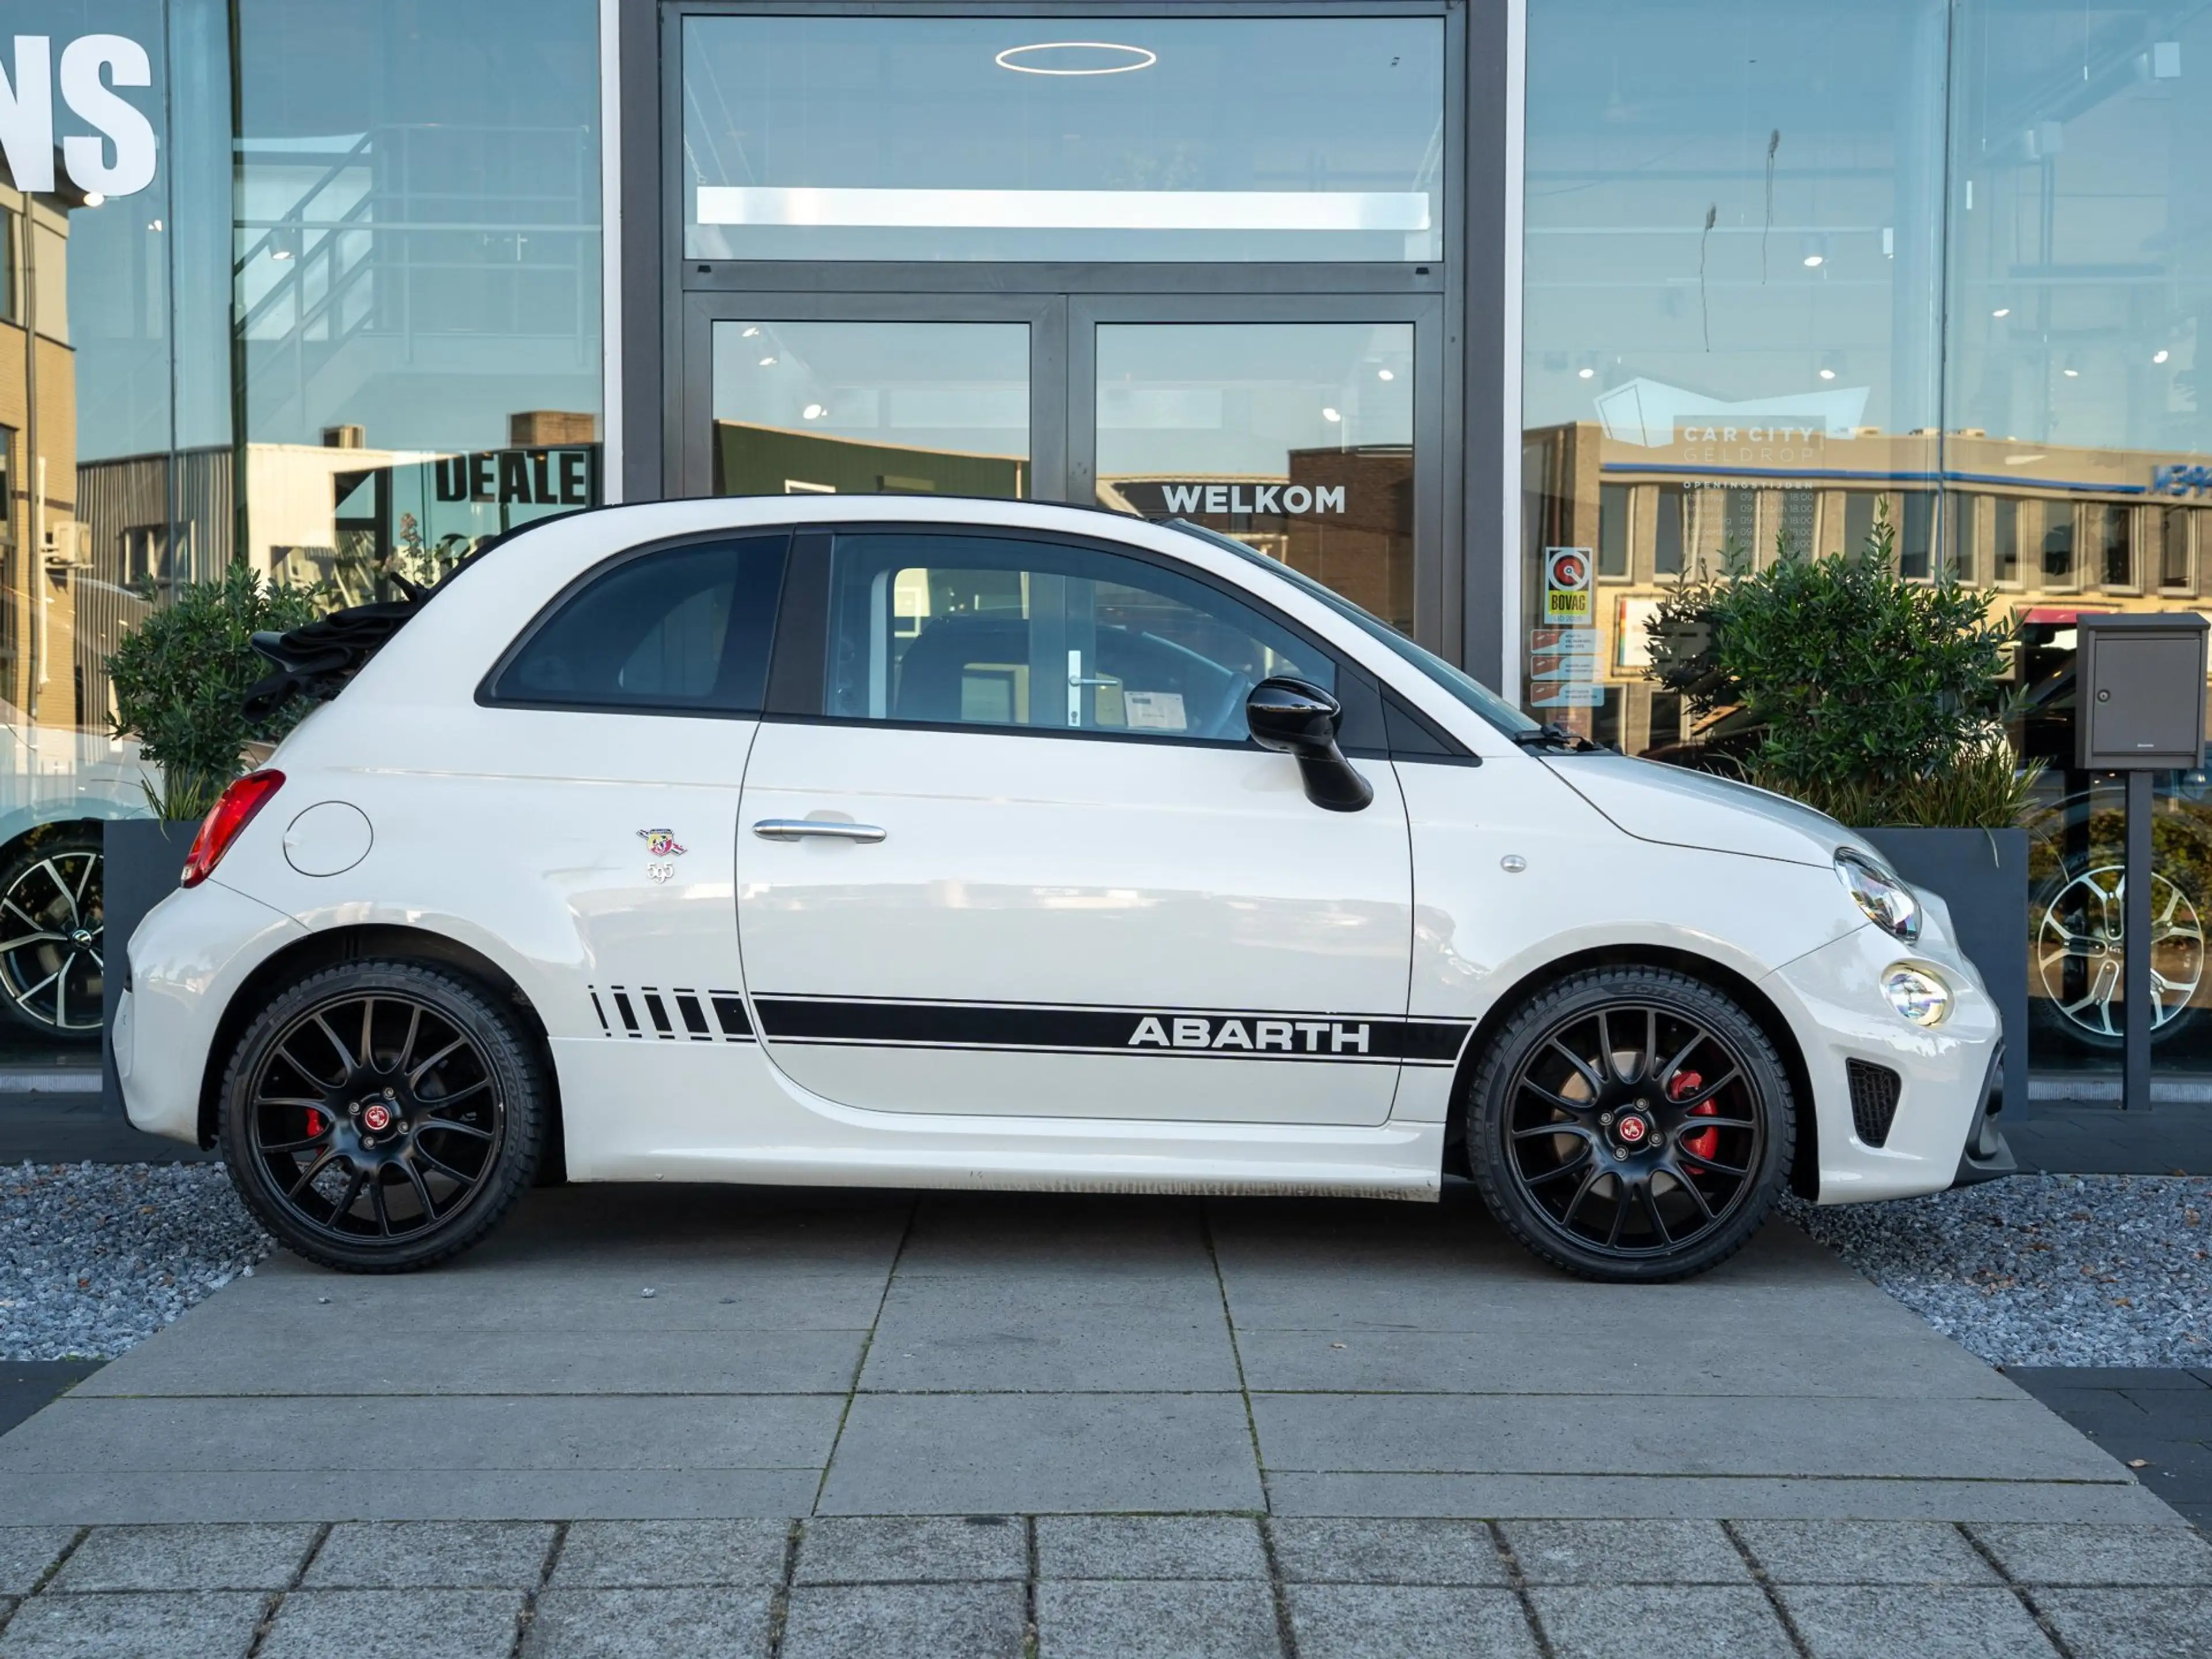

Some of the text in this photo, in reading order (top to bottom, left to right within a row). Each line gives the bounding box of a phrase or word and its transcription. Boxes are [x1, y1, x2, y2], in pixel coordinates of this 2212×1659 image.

[1683, 426, 1814, 442] CAR CITY
[1683, 447, 1814, 463] GELDROP
[1683, 481, 1813, 489] OPENINGSTIJDEN
[1162, 485, 1346, 514] WELKOM
[1552, 594, 1585, 611] BOVAG
[647, 862, 675, 884] 595
[1619, 983, 1744, 1037] SOTTOZERO
[1127, 1016, 1370, 1053] ABARTH
[482, 1031, 520, 1157] SOTTOZERO
